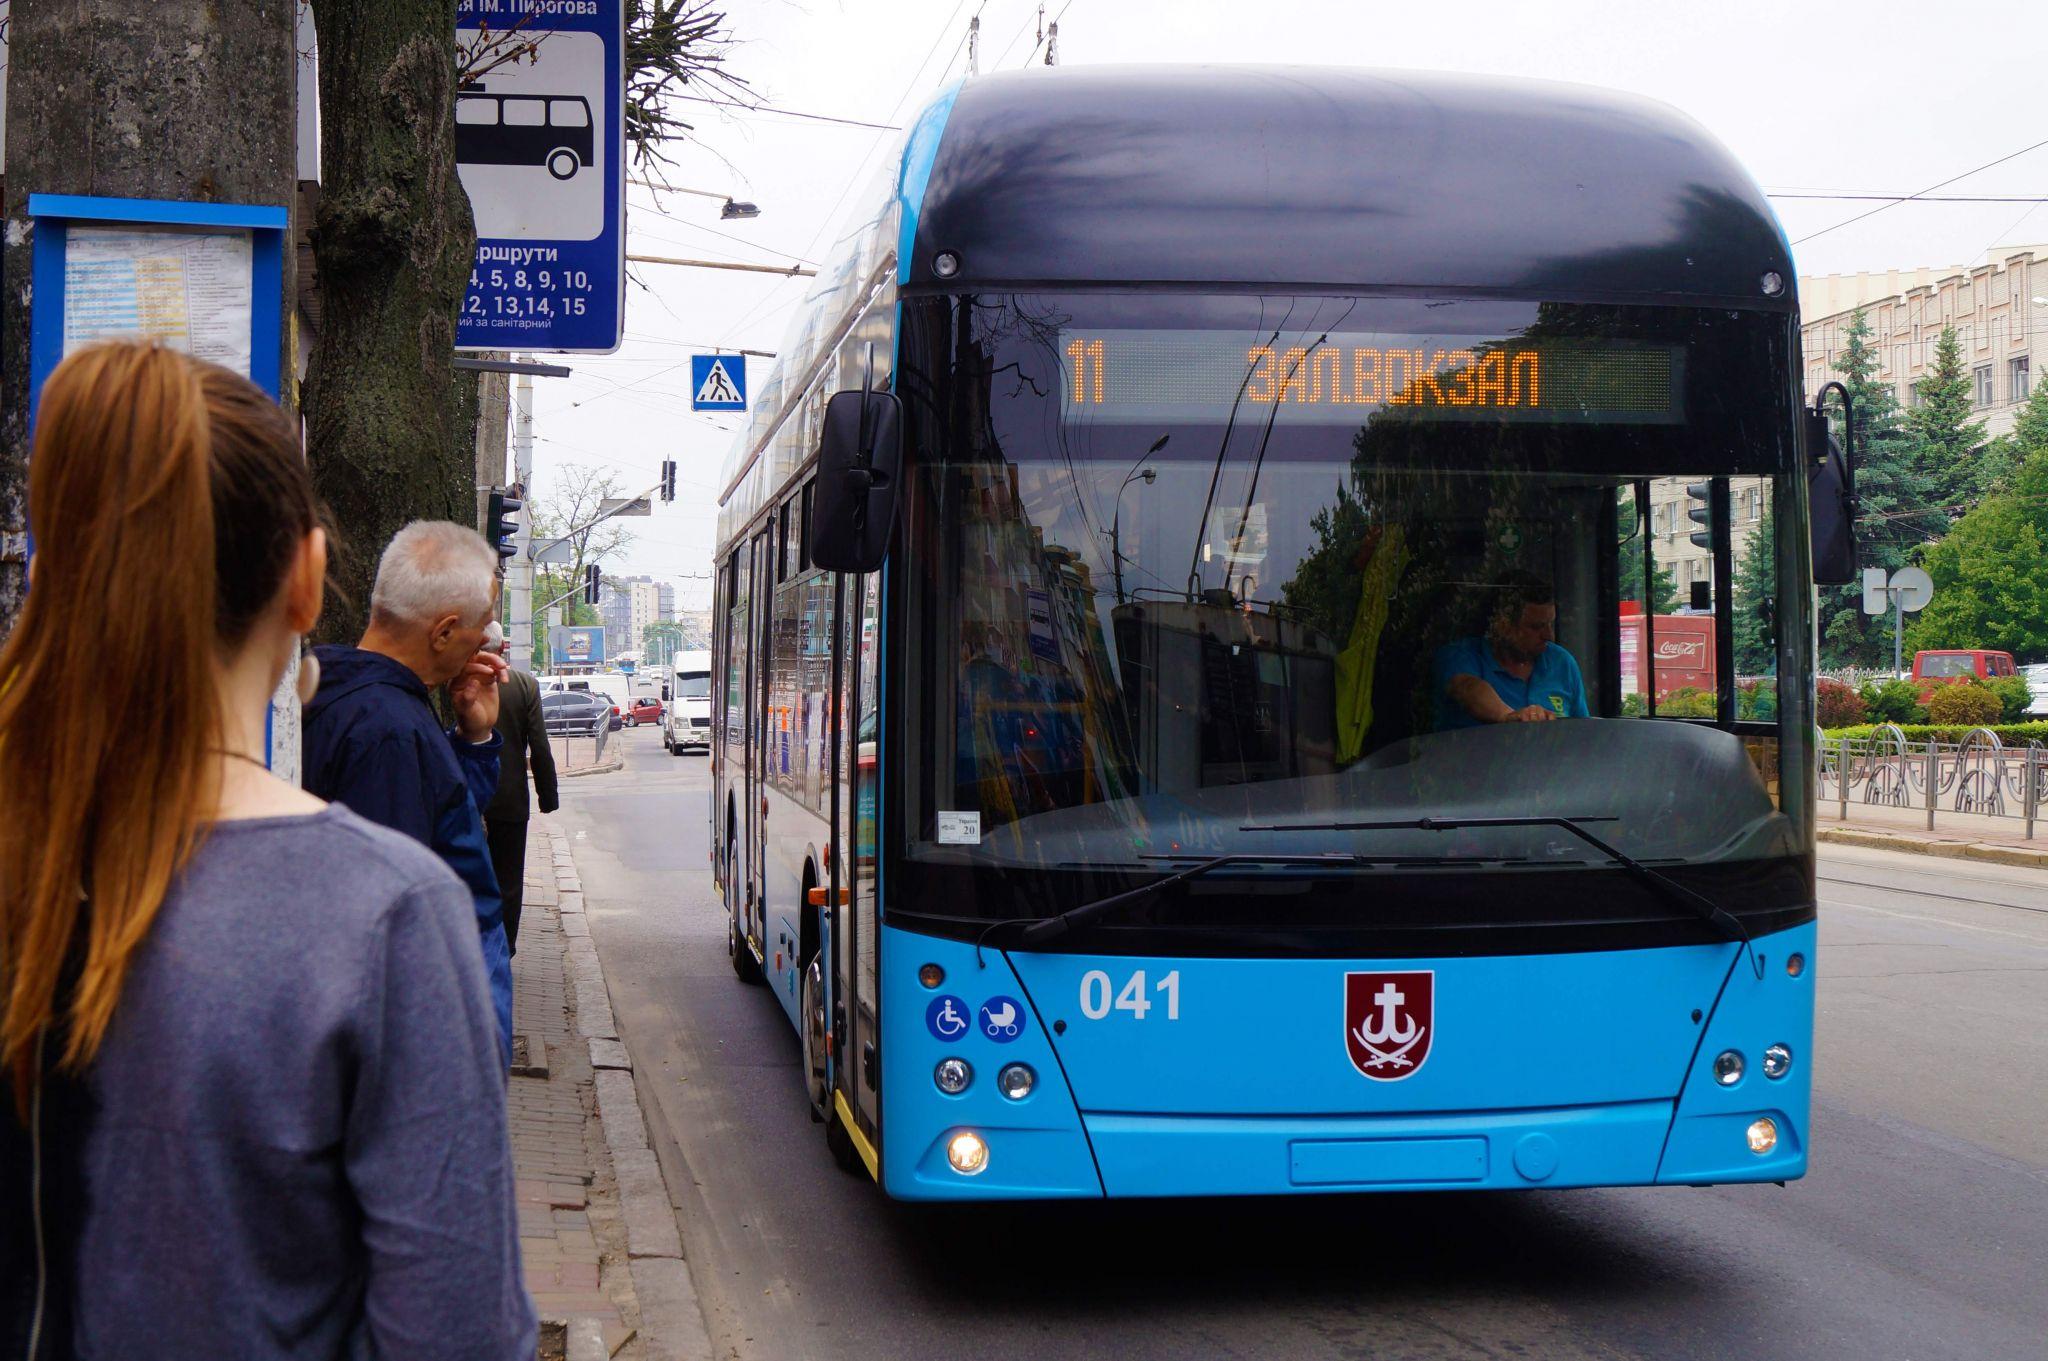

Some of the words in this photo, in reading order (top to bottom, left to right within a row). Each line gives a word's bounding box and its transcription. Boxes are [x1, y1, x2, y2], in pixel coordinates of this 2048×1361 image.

[510, 0, 597, 17] Пирогова
[475, 246, 558, 266] ршрути
[490, 269, 508, 291] 5,
[514, 270, 532, 291] 8,
[538, 271, 556, 292] 9,
[563, 271, 592, 292] 10,
[562, 298, 586, 315] 15
[459, 317, 473, 327] ий
[475, 319, 488, 327] за
[491, 318, 552, 330] санітарний
[1067, 339, 1104, 403] 11
[963, 825, 975, 835] 20
[1080, 970, 1179, 1020] 041
